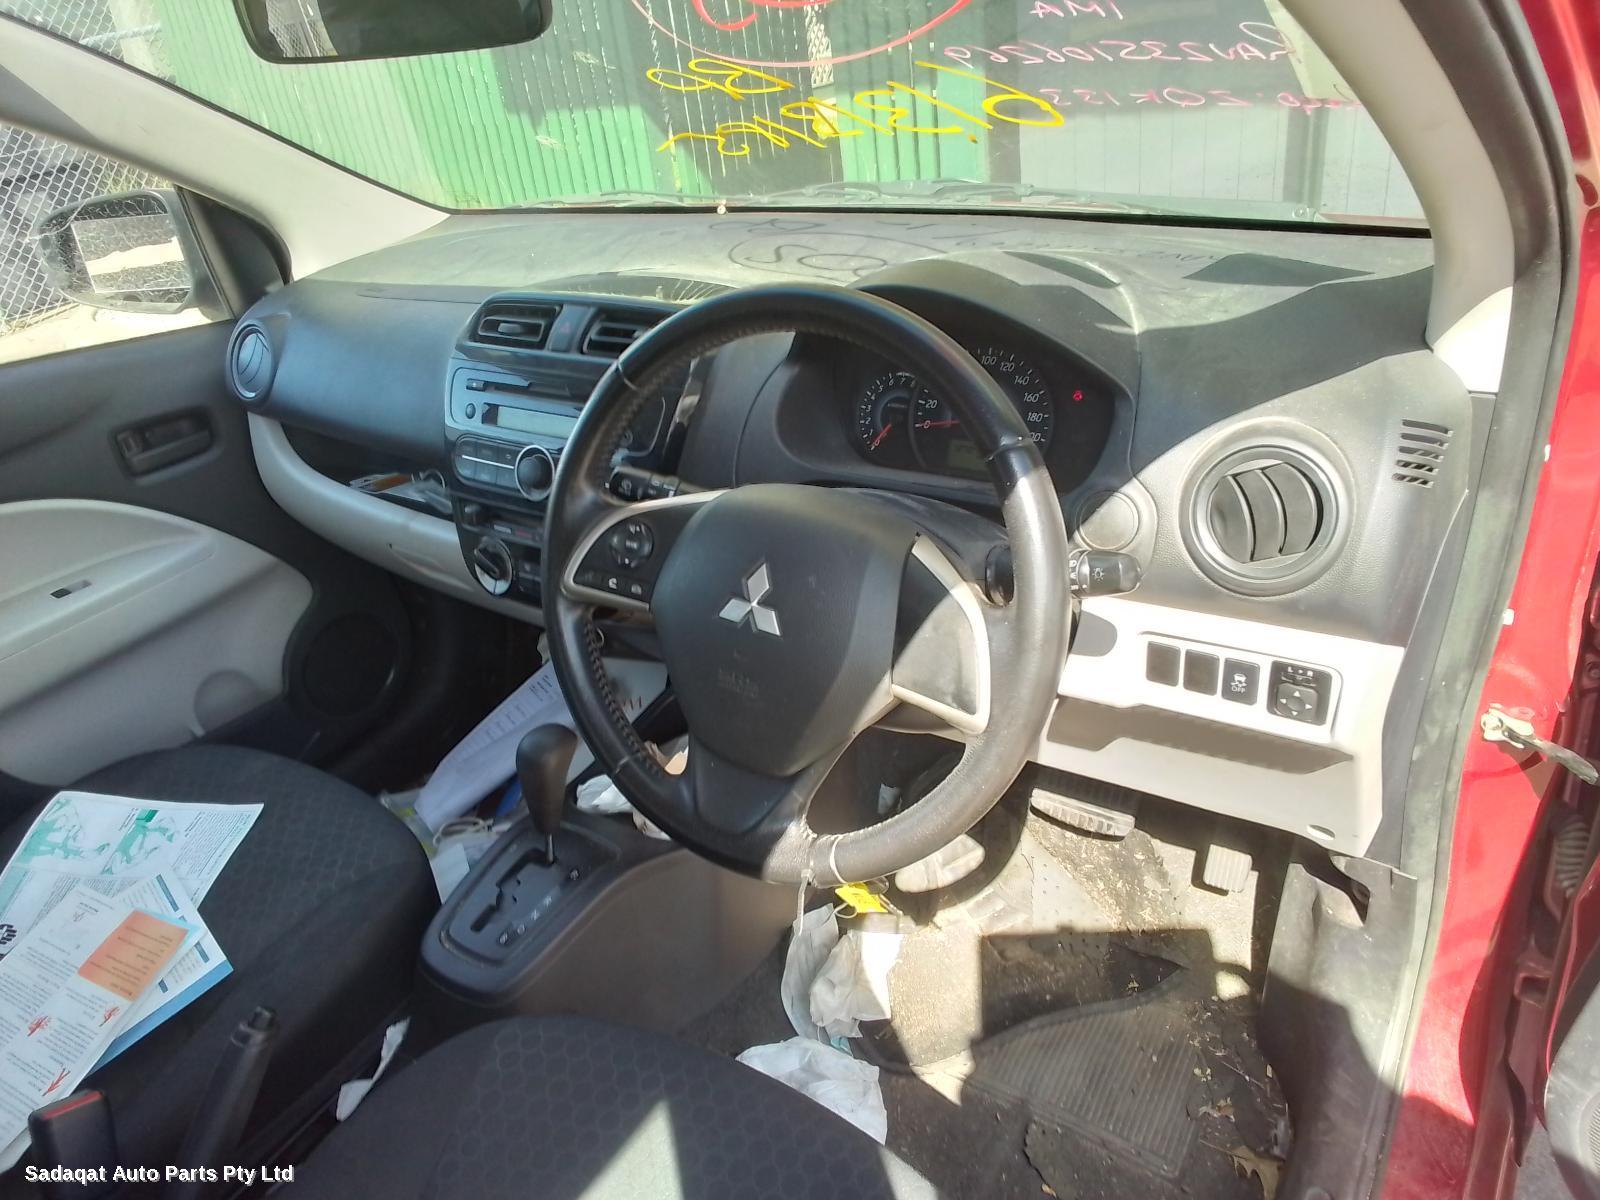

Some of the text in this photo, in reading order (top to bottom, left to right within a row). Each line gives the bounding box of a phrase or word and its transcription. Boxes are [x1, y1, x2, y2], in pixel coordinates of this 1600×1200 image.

[980, 355, 997, 366] 100
[1000, 361, 1015, 372] 120
[1014, 375, 1030, 386] 140
[1024, 392, 1039, 403] 160
[925, 399, 938, 409] 20
[1027, 411, 1043, 422] 180
